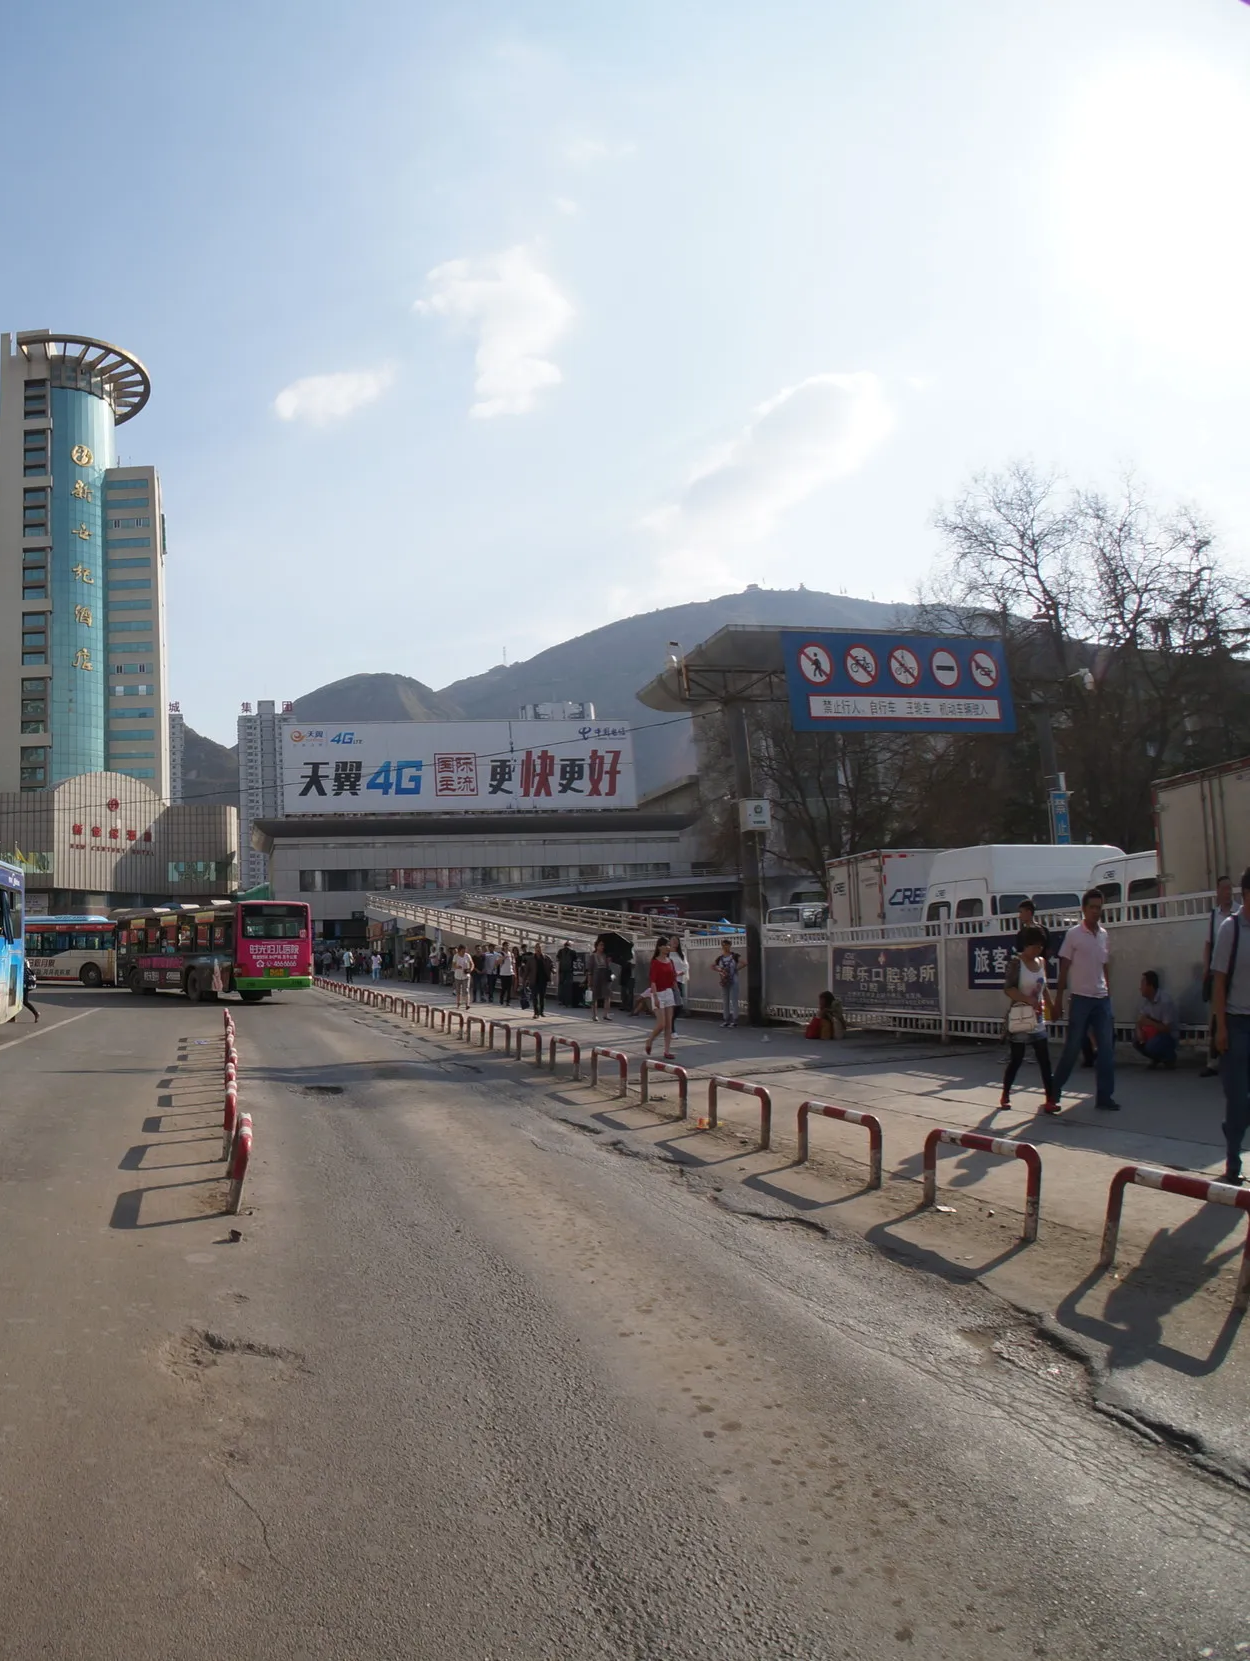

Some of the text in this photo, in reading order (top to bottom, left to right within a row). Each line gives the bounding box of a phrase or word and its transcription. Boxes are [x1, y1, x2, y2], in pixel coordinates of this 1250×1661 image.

[71, 479, 94, 672] 新世纪酒店
[330, 732, 354, 744] 4G
[299, 749, 621, 797] 天翼 4G 国际 更快更好
[438, 775, 475, 793] 主流
[974, 946, 1021, 974] 旅客
